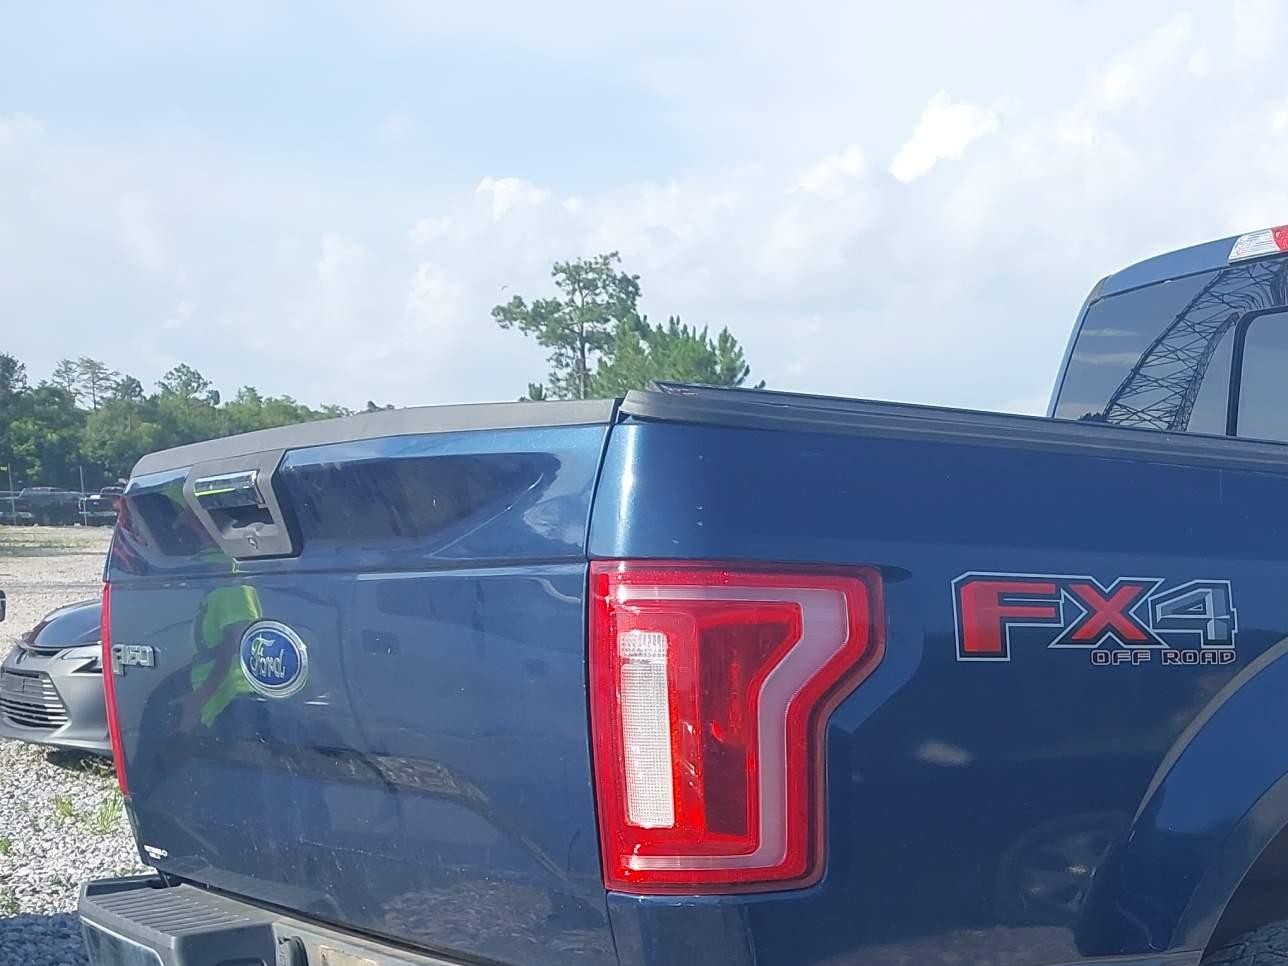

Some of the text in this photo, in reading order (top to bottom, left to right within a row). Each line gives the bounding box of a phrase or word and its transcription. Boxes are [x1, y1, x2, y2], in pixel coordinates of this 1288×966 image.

[951, 571, 1238, 662] FX4
[250, 633, 287, 679] Ford
[1091, 649, 1237, 665] OFF ROAD
